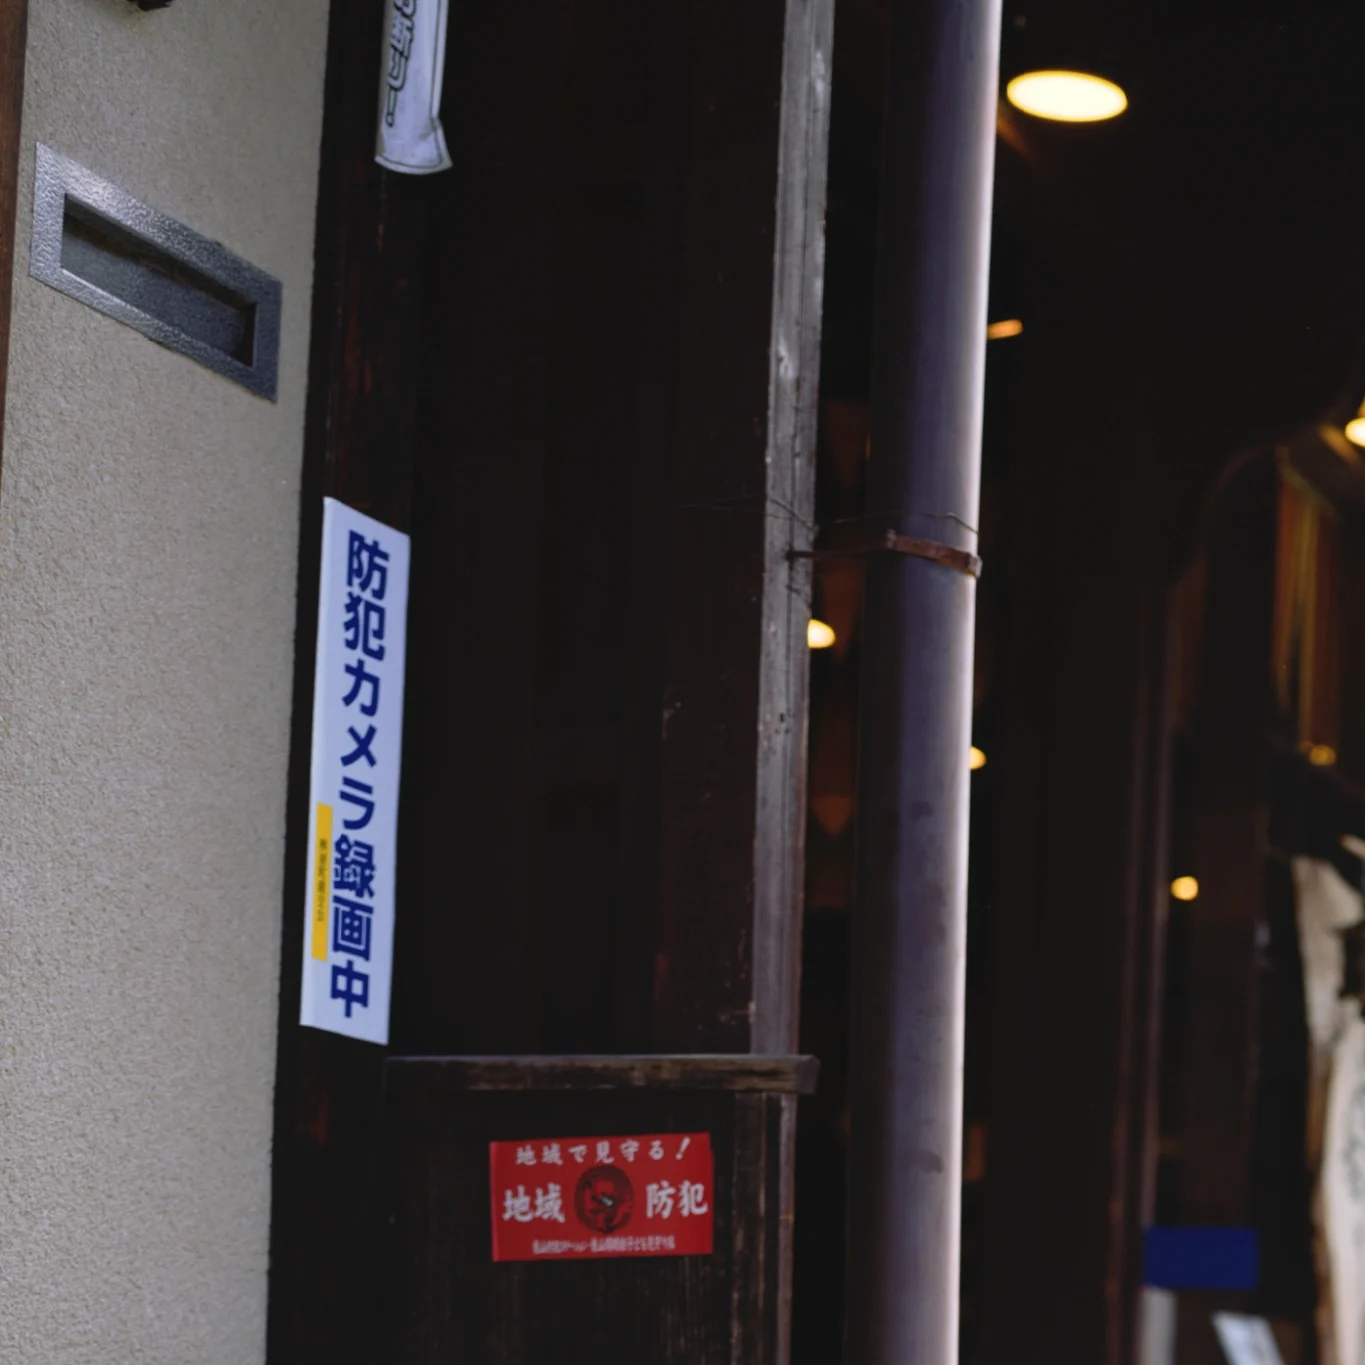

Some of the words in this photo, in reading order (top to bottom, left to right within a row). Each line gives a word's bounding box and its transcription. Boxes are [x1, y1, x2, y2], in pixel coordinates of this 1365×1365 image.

[330, 529, 390, 1018] 防犯カメラ録画中
[503, 1182, 566, 1224] 地域
[645, 1179, 709, 1220] 防犯
